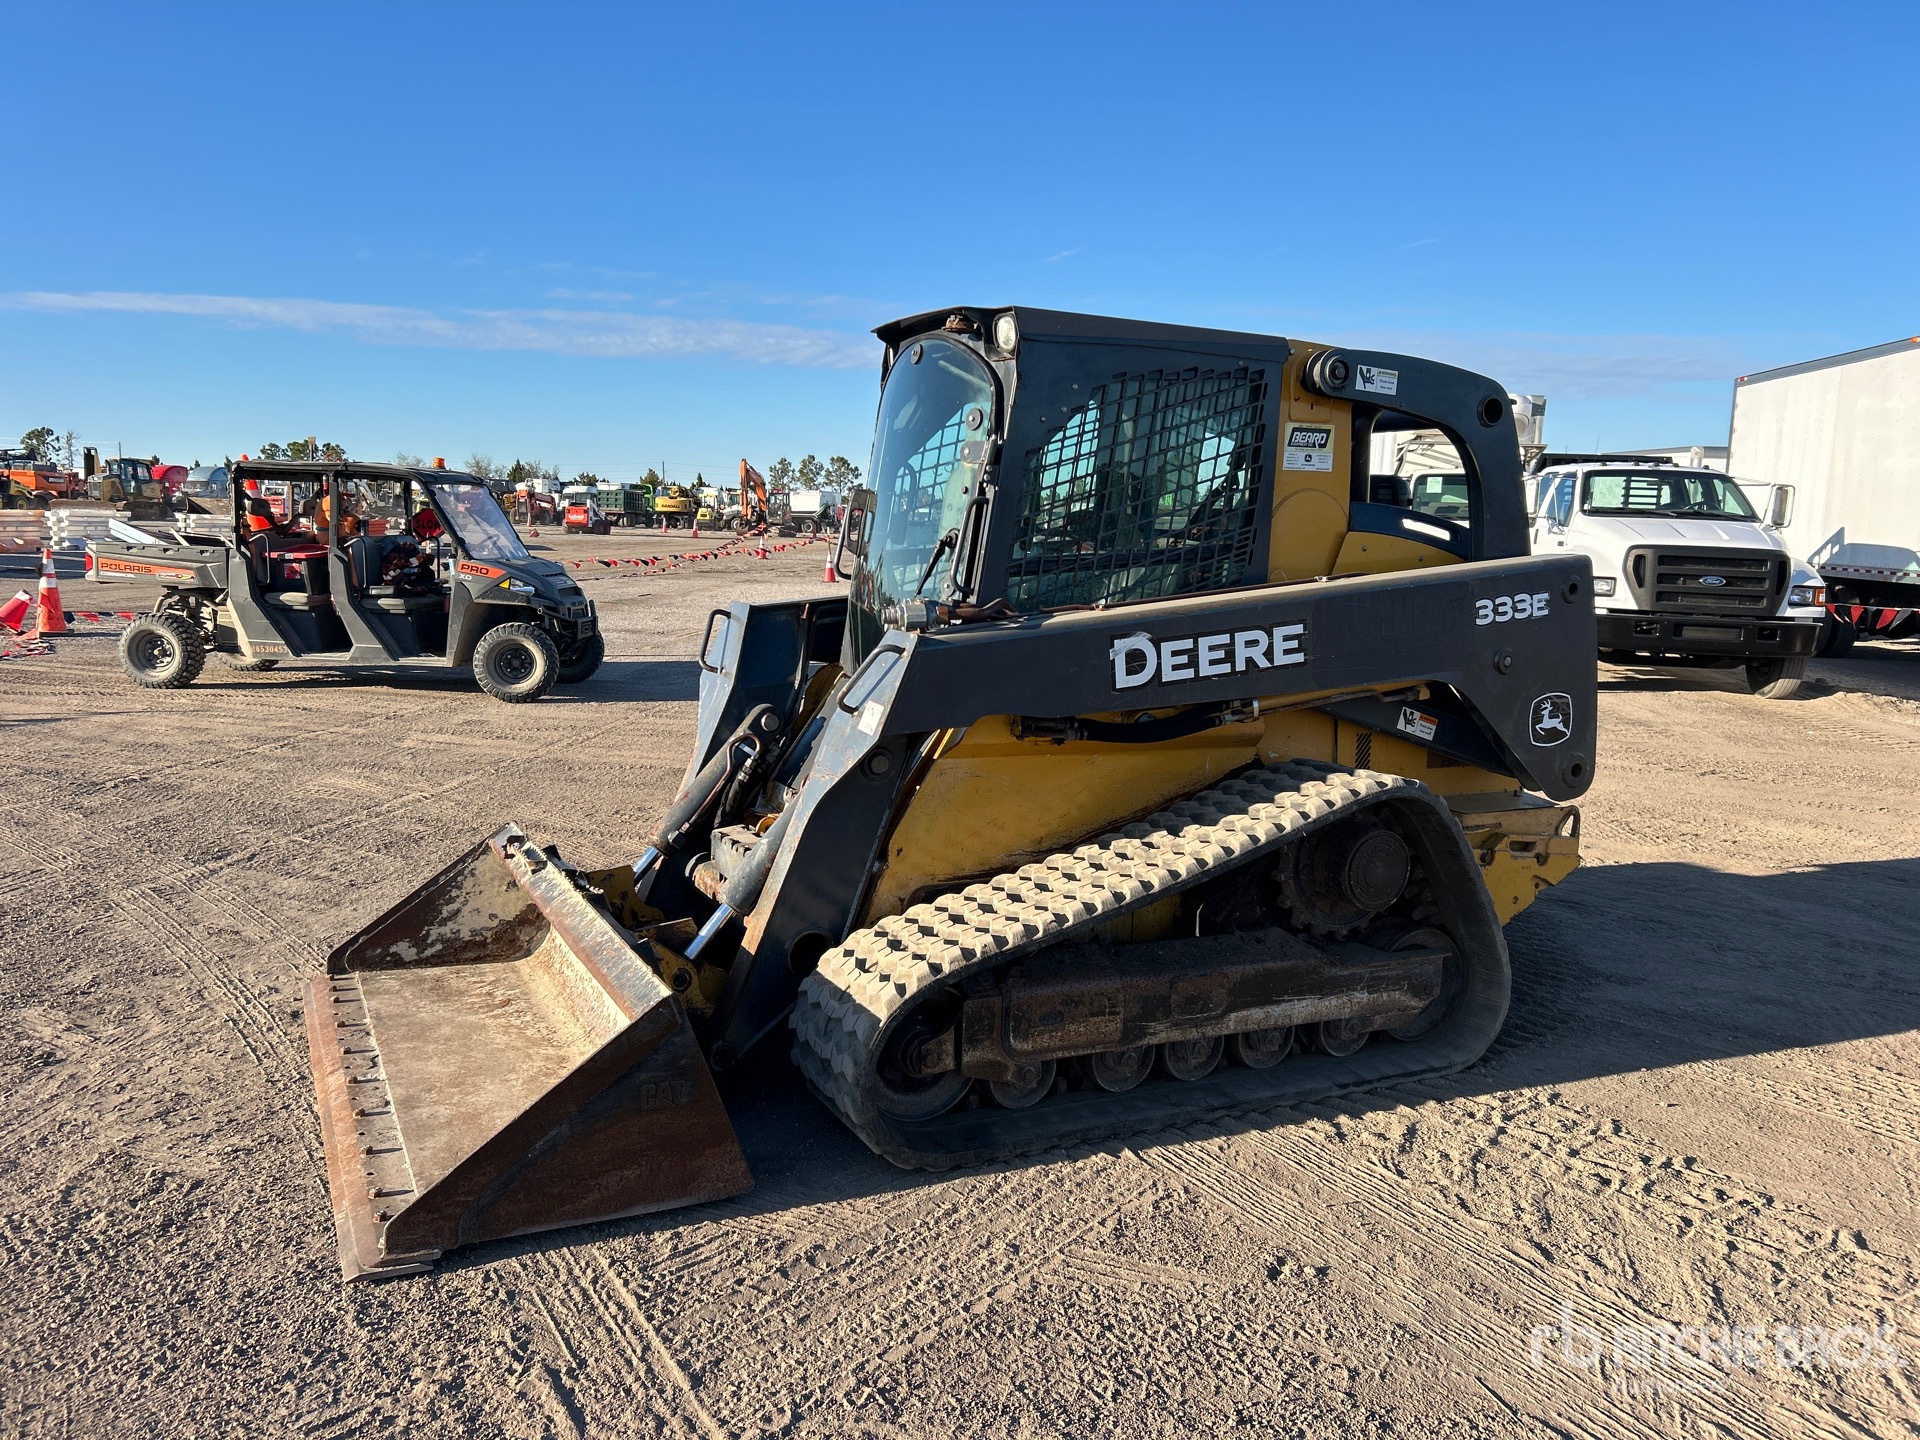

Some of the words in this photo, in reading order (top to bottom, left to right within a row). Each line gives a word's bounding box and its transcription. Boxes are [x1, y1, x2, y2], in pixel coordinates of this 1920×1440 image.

[1292, 431, 1327, 448] BEARD
[415, 519, 442, 529] SLOW
[100, 562, 152, 573] POLARIS
[460, 563, 490, 575] PRO
[459, 573, 472, 581] XD
[1474, 592, 1550, 626] 333E
[1110, 623, 1306, 690] DEERE
[640, 1080, 686, 1110] CAT
